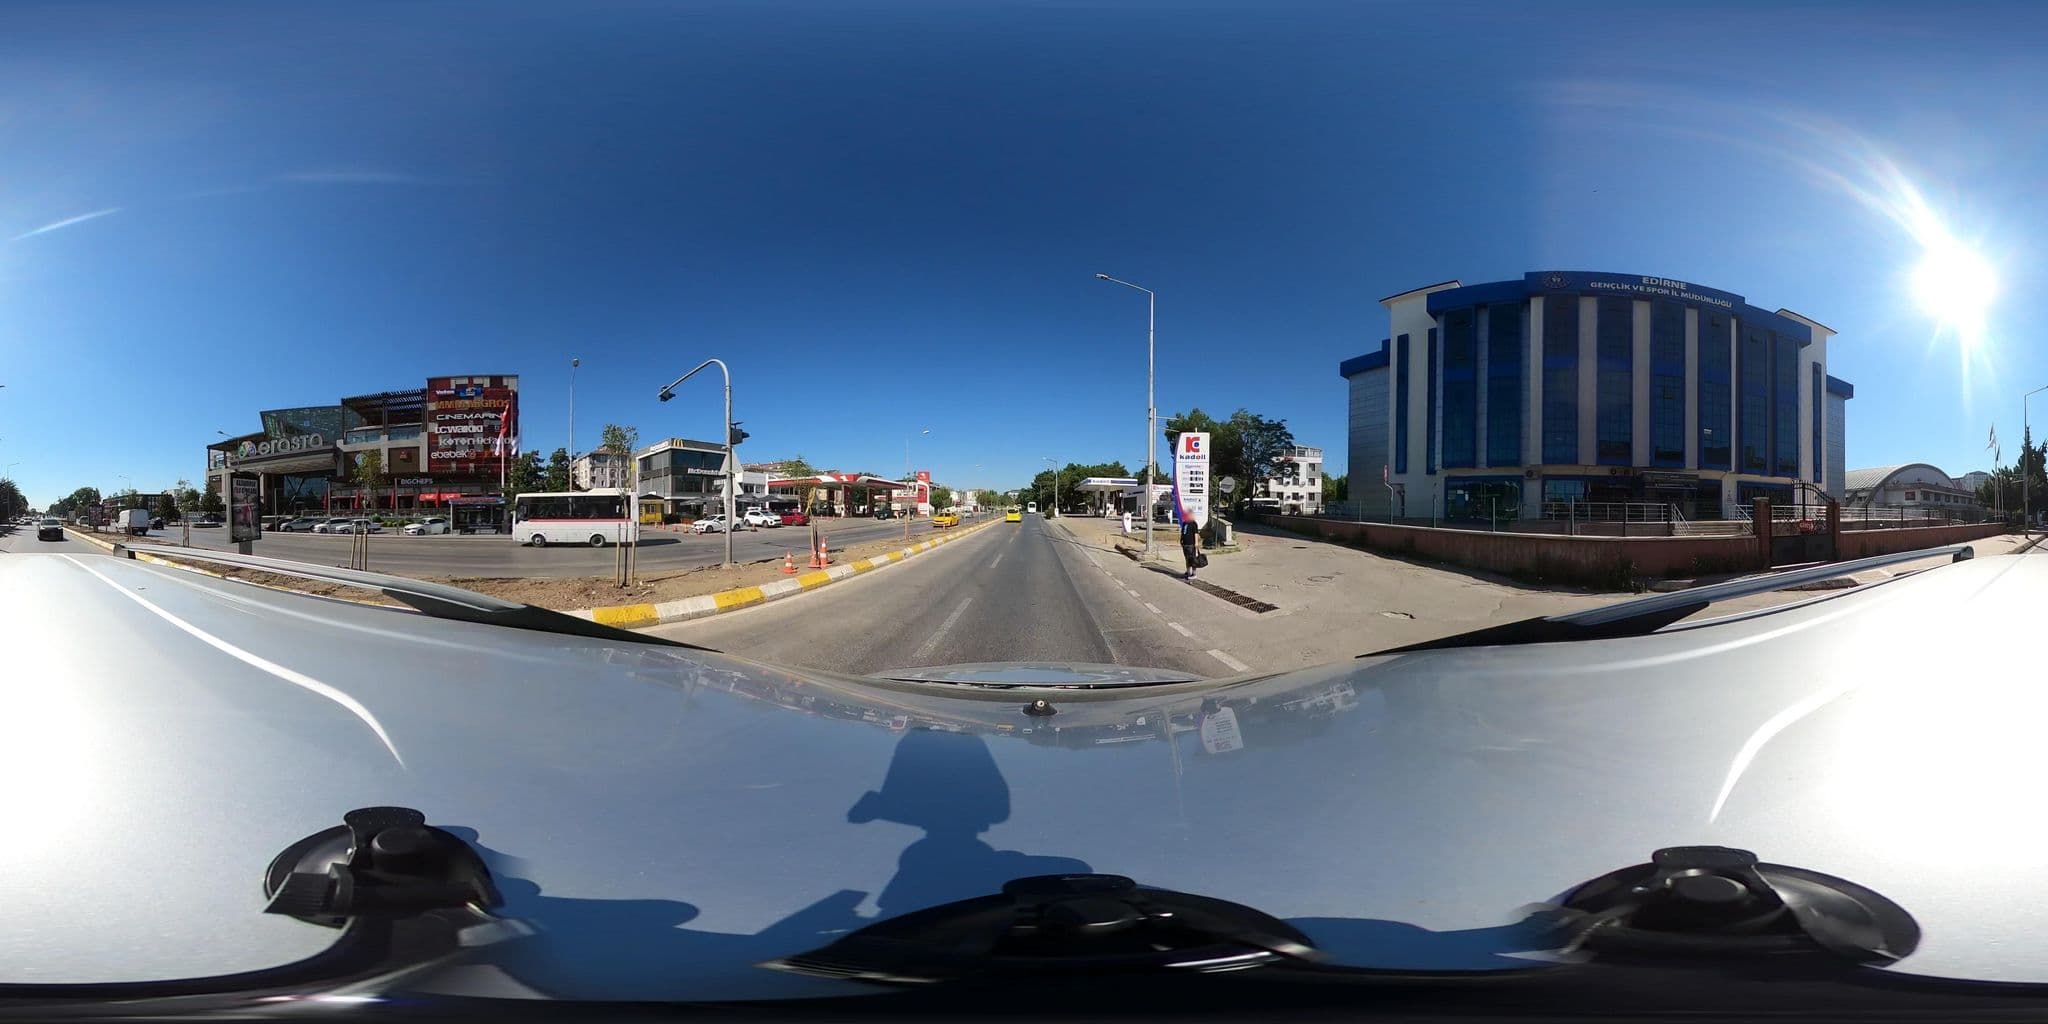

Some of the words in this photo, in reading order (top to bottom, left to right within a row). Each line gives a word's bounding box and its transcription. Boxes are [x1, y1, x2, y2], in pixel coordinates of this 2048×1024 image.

[1590, 282, 1630, 290] GENÇLİK
[1646, 286, 1670, 296] SPOR
[1642, 277, 1687, 290] EDİRNE
